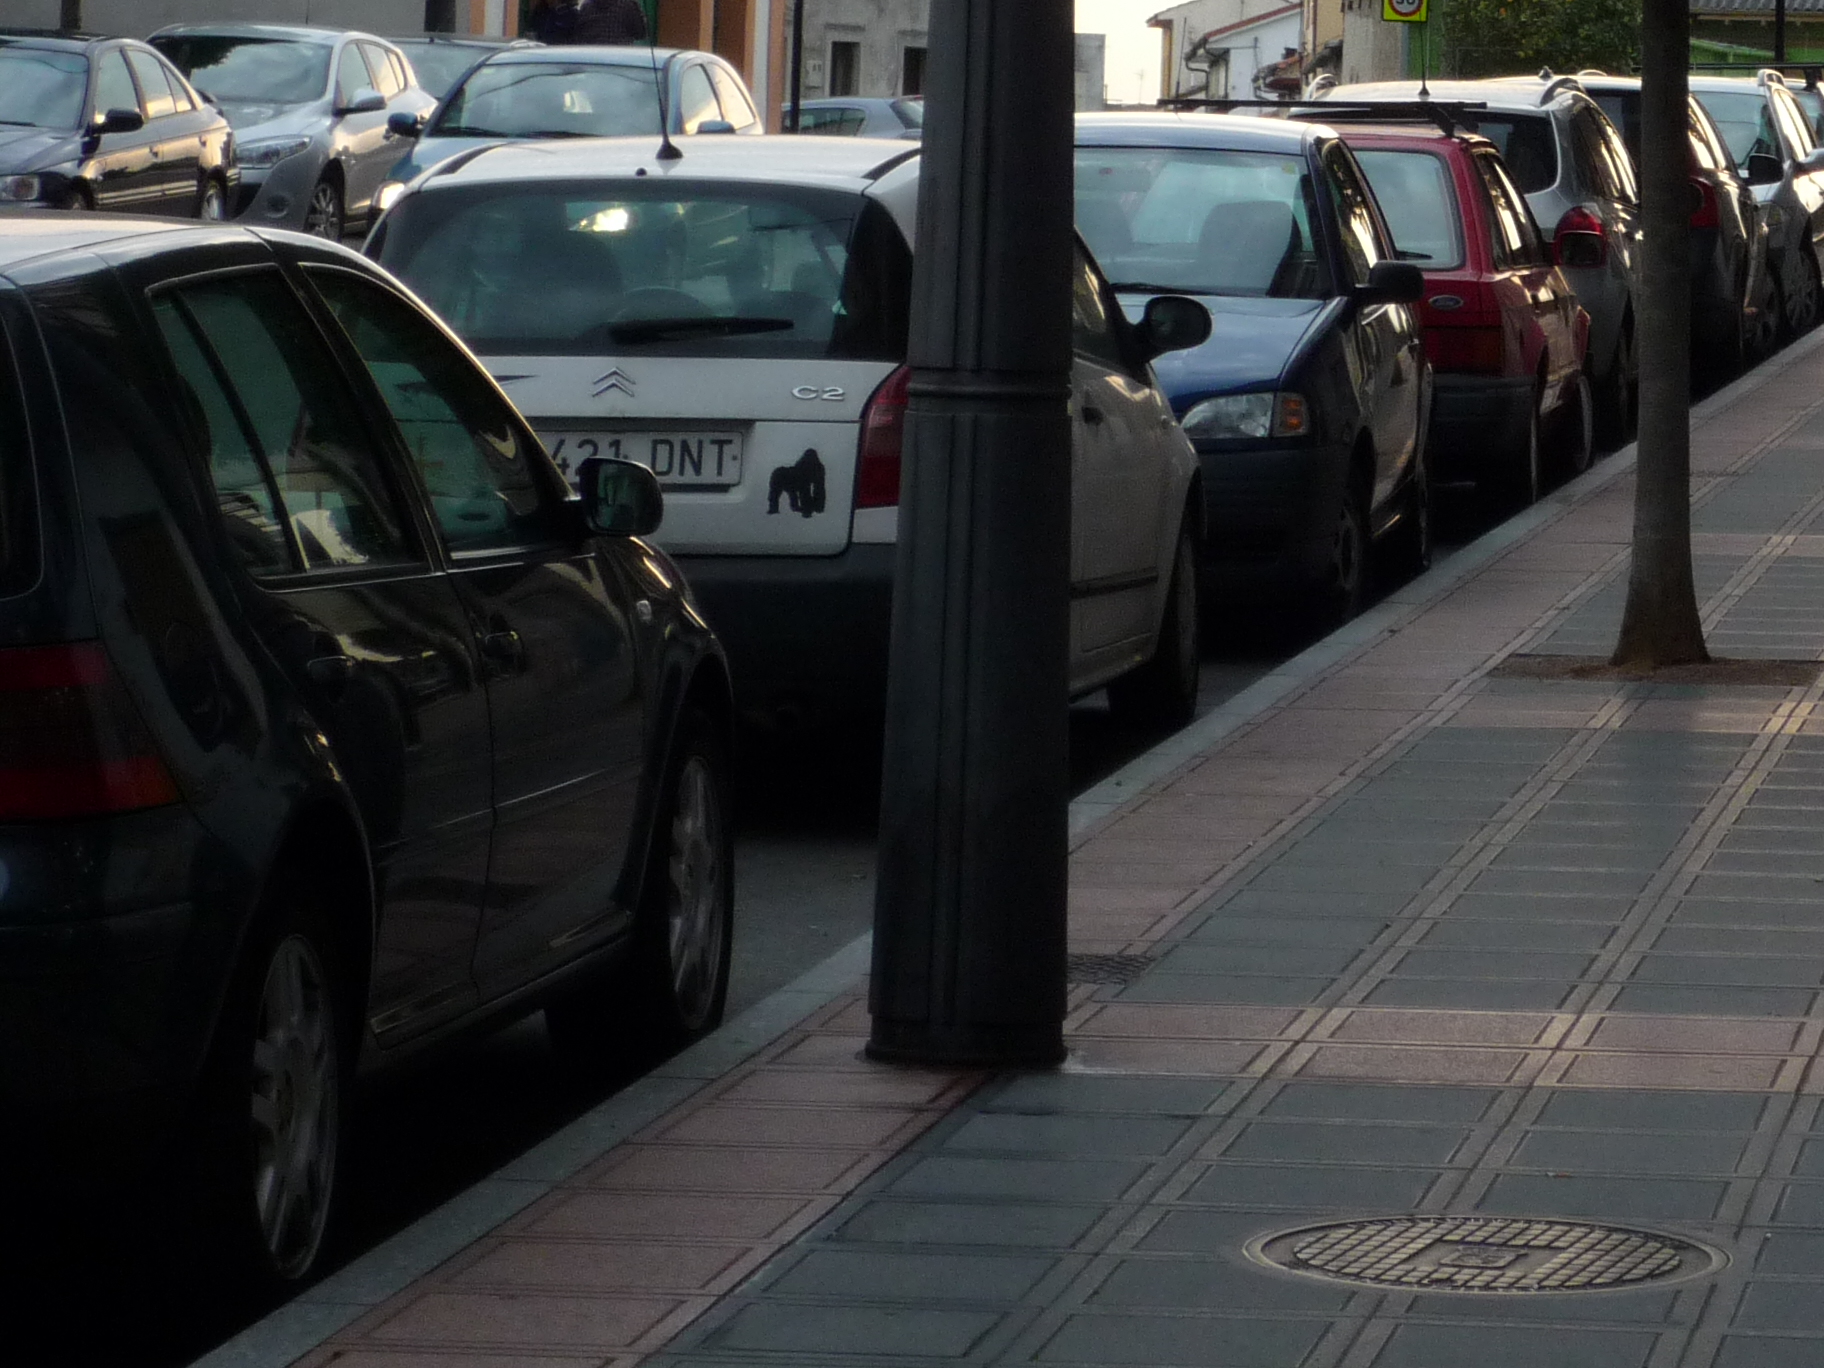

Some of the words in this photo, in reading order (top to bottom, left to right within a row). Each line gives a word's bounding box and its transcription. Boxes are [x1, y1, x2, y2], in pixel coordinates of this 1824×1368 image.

[791, 385, 845, 401] C2
[550, 438, 622, 477] 421
[650, 438, 733, 477] DNT
